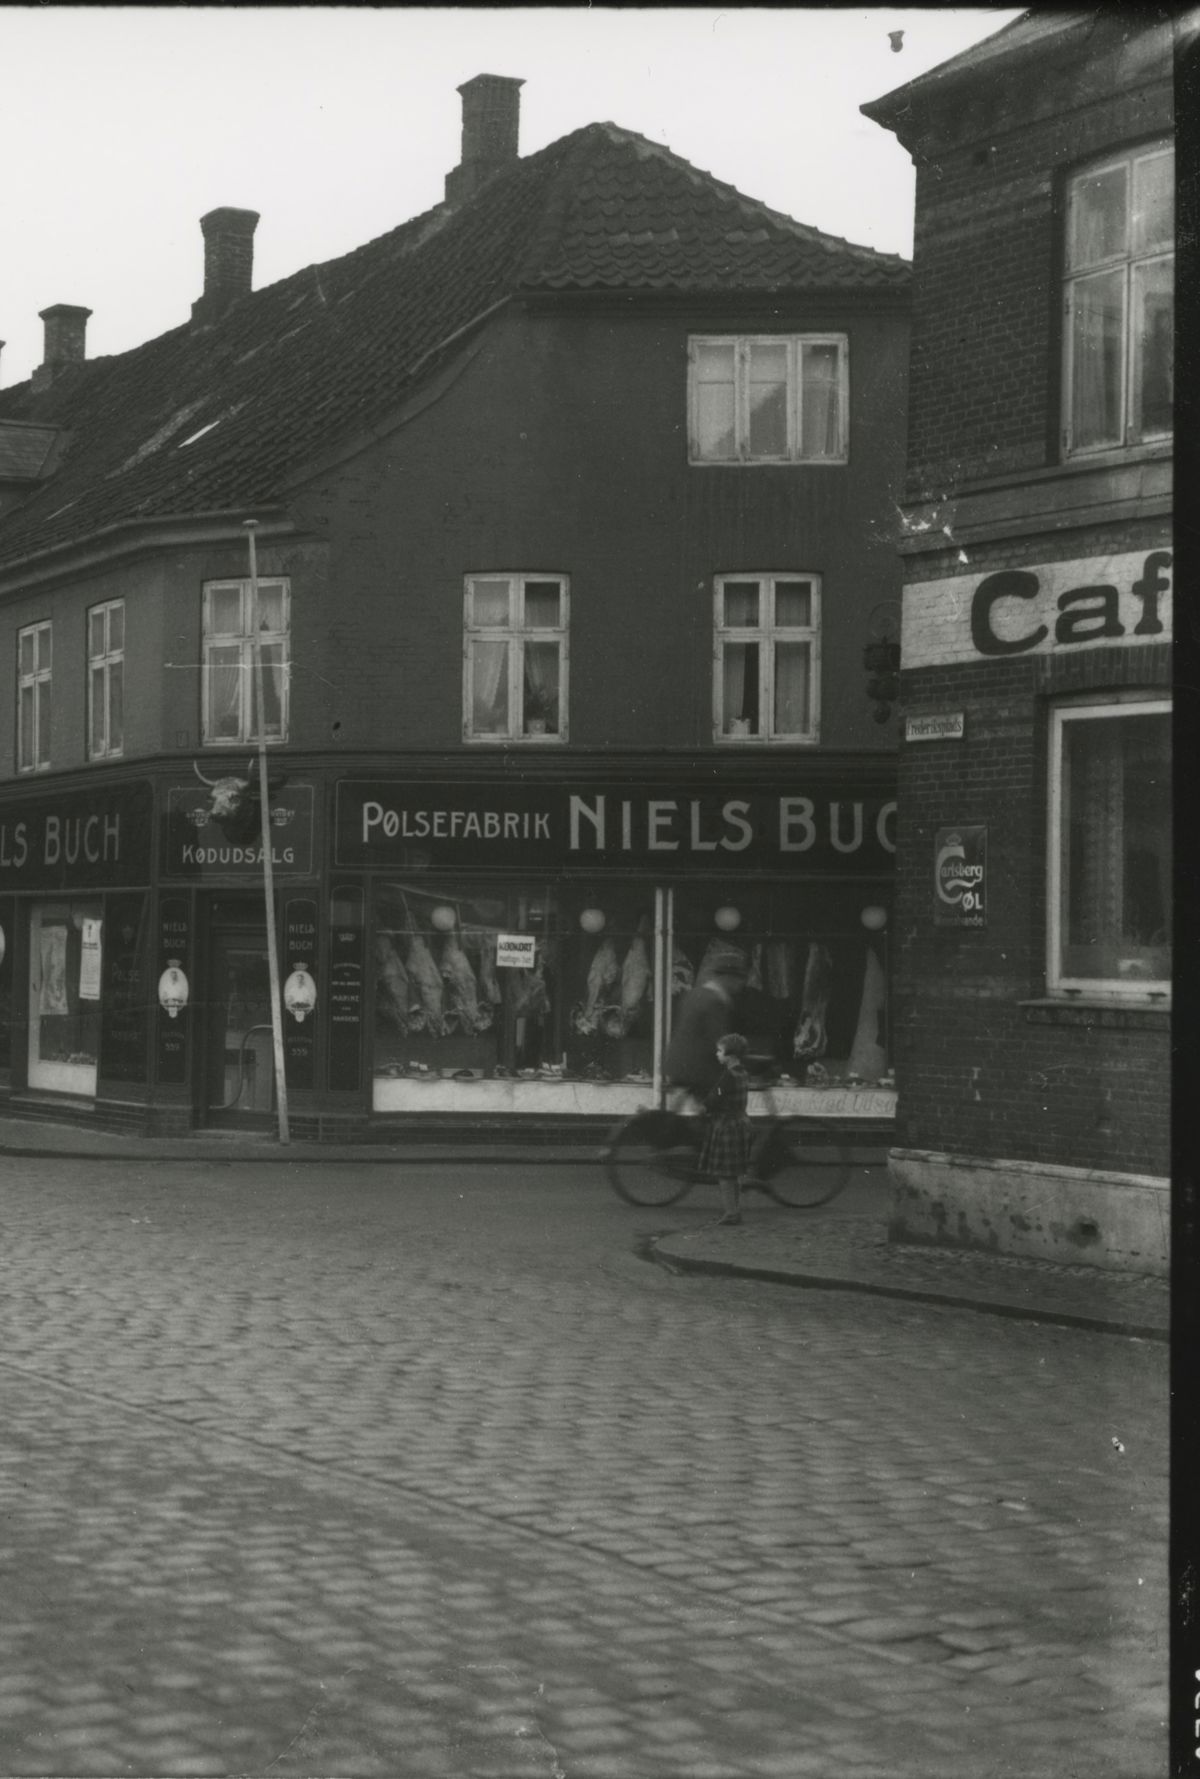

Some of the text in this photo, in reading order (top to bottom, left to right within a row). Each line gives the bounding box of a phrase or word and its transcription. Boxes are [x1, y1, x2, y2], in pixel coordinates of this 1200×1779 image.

[44, 813, 120, 865] BUCH
[362, 802, 551, 842] PØLSEFABRIK
[569, 795, 752, 852] NIELS
[182, 844, 295, 864] KØDUDSALG
[936, 846, 983, 904] Carlsberg
[962, 891, 983, 911] ØL
